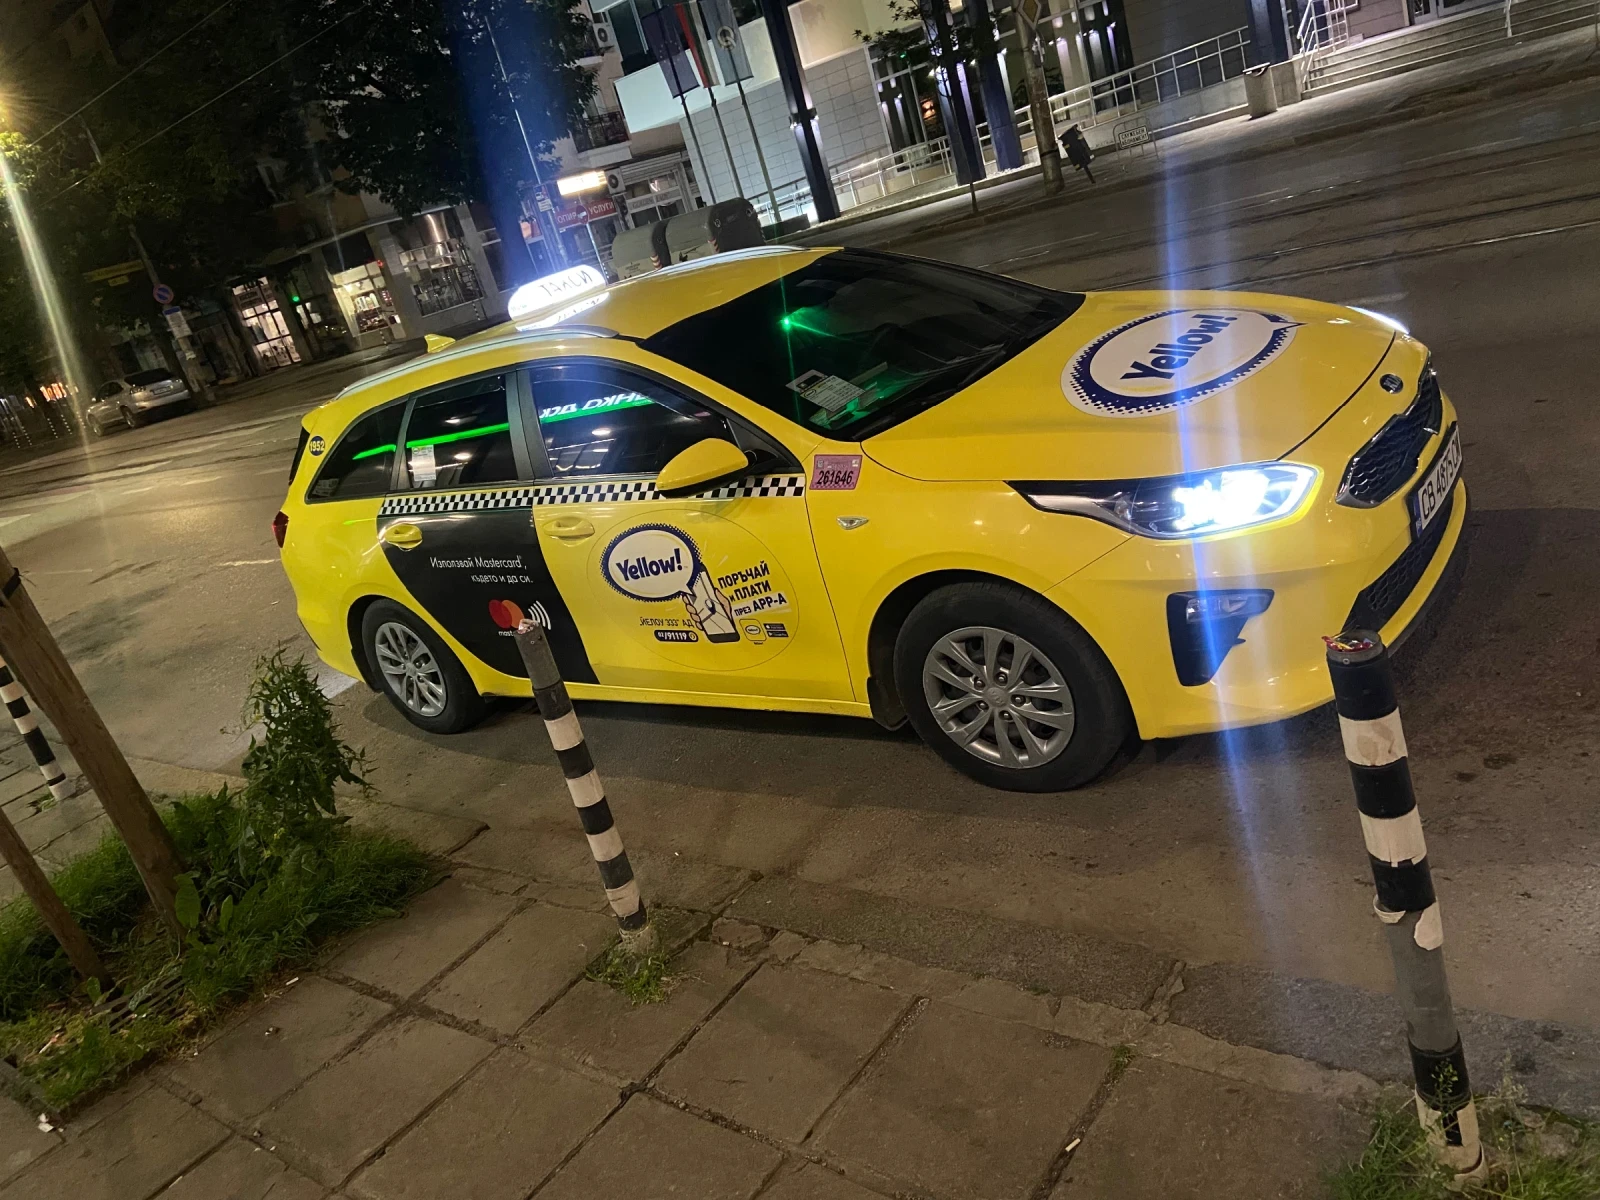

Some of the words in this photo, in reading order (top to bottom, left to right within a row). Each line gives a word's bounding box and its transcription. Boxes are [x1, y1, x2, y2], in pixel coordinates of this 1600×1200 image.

[557, 211, 577, 224] ОПИР
[589, 201, 615, 215] УСЛУГИ
[1120, 313, 1238, 380] Yellow!
[310, 440, 325, 452] 1952
[817, 470, 854, 485] 261646
[1421, 480, 1436, 520] CB
[430, 556, 474, 568] Използвай
[616, 548, 683, 581] Yellow!
[470, 575, 498, 584] където
[499, 575, 506, 583] и
[507, 575, 519, 585] да
[718, 560, 770, 589] ПОРЪЧАЙ
[734, 580, 772, 601] ПЛАТИ
[734, 606, 752, 616] ПРЕЗ
